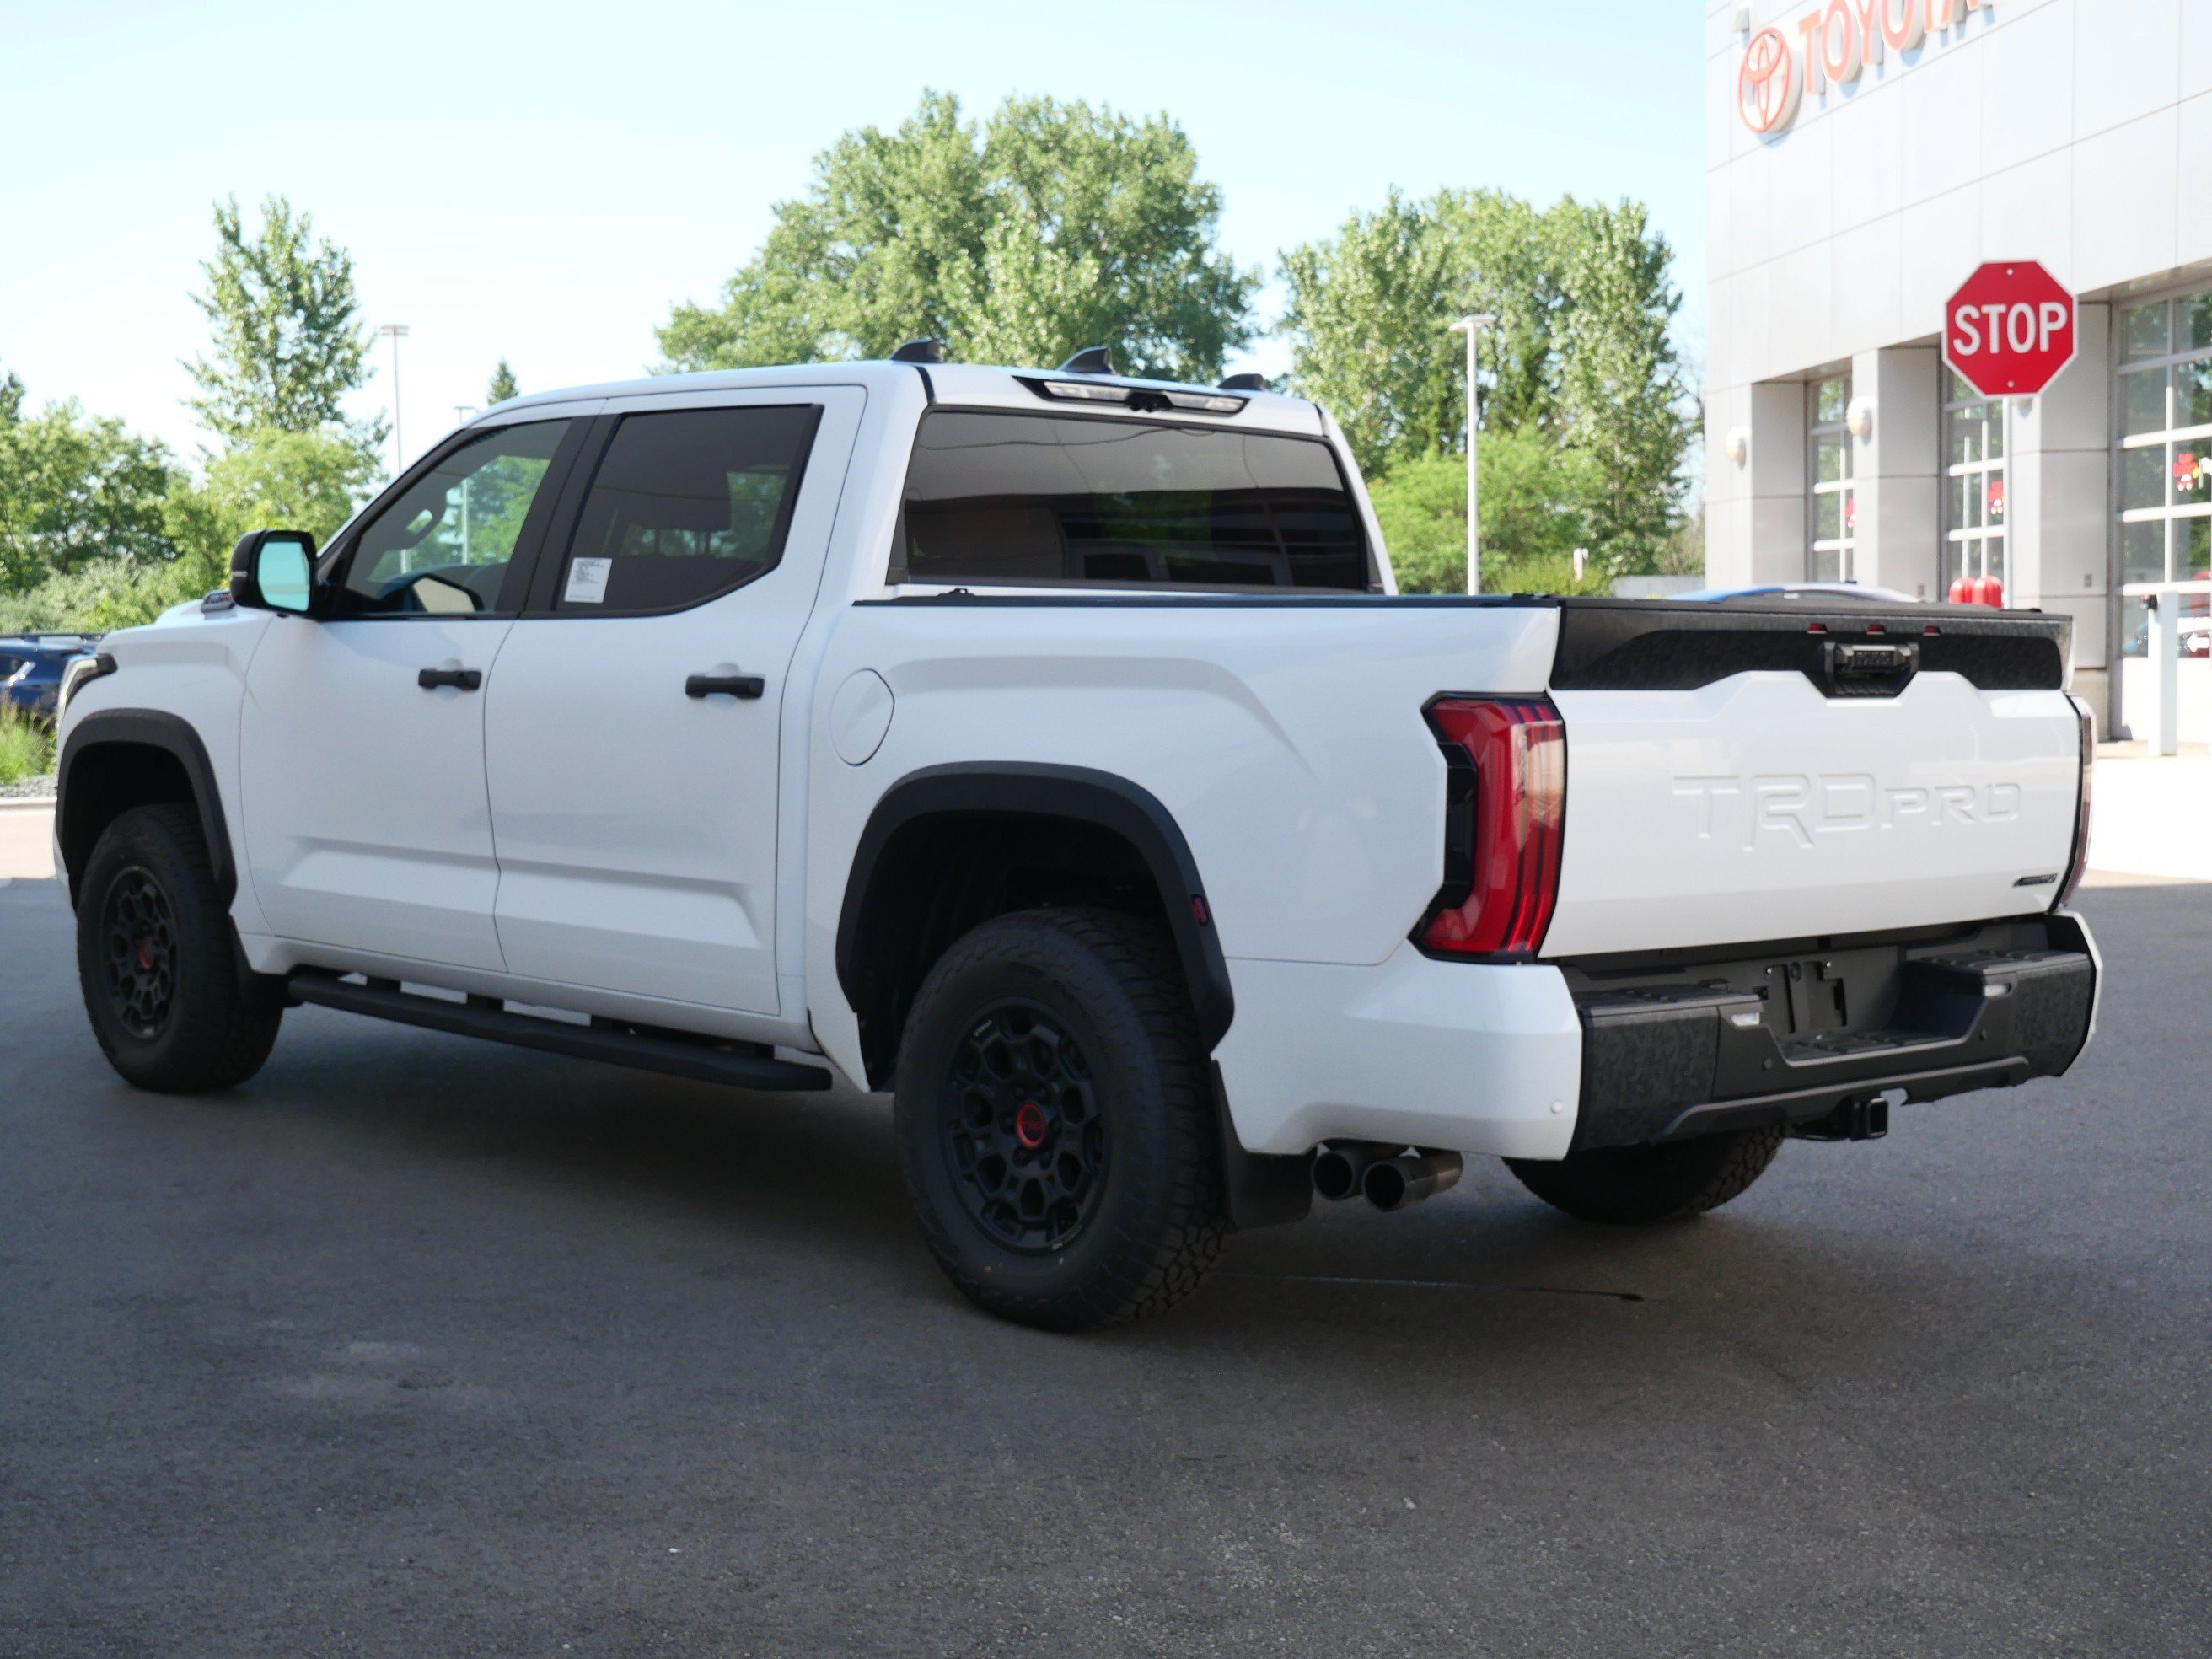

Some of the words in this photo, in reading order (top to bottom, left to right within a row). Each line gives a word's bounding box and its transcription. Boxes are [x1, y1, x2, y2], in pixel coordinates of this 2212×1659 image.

[1799, 0, 1980, 95] TOYO
[1953, 302, 2068, 356] STOP
[1672, 773, 1876, 851] TRD
[1881, 783, 2021, 830] PRO
